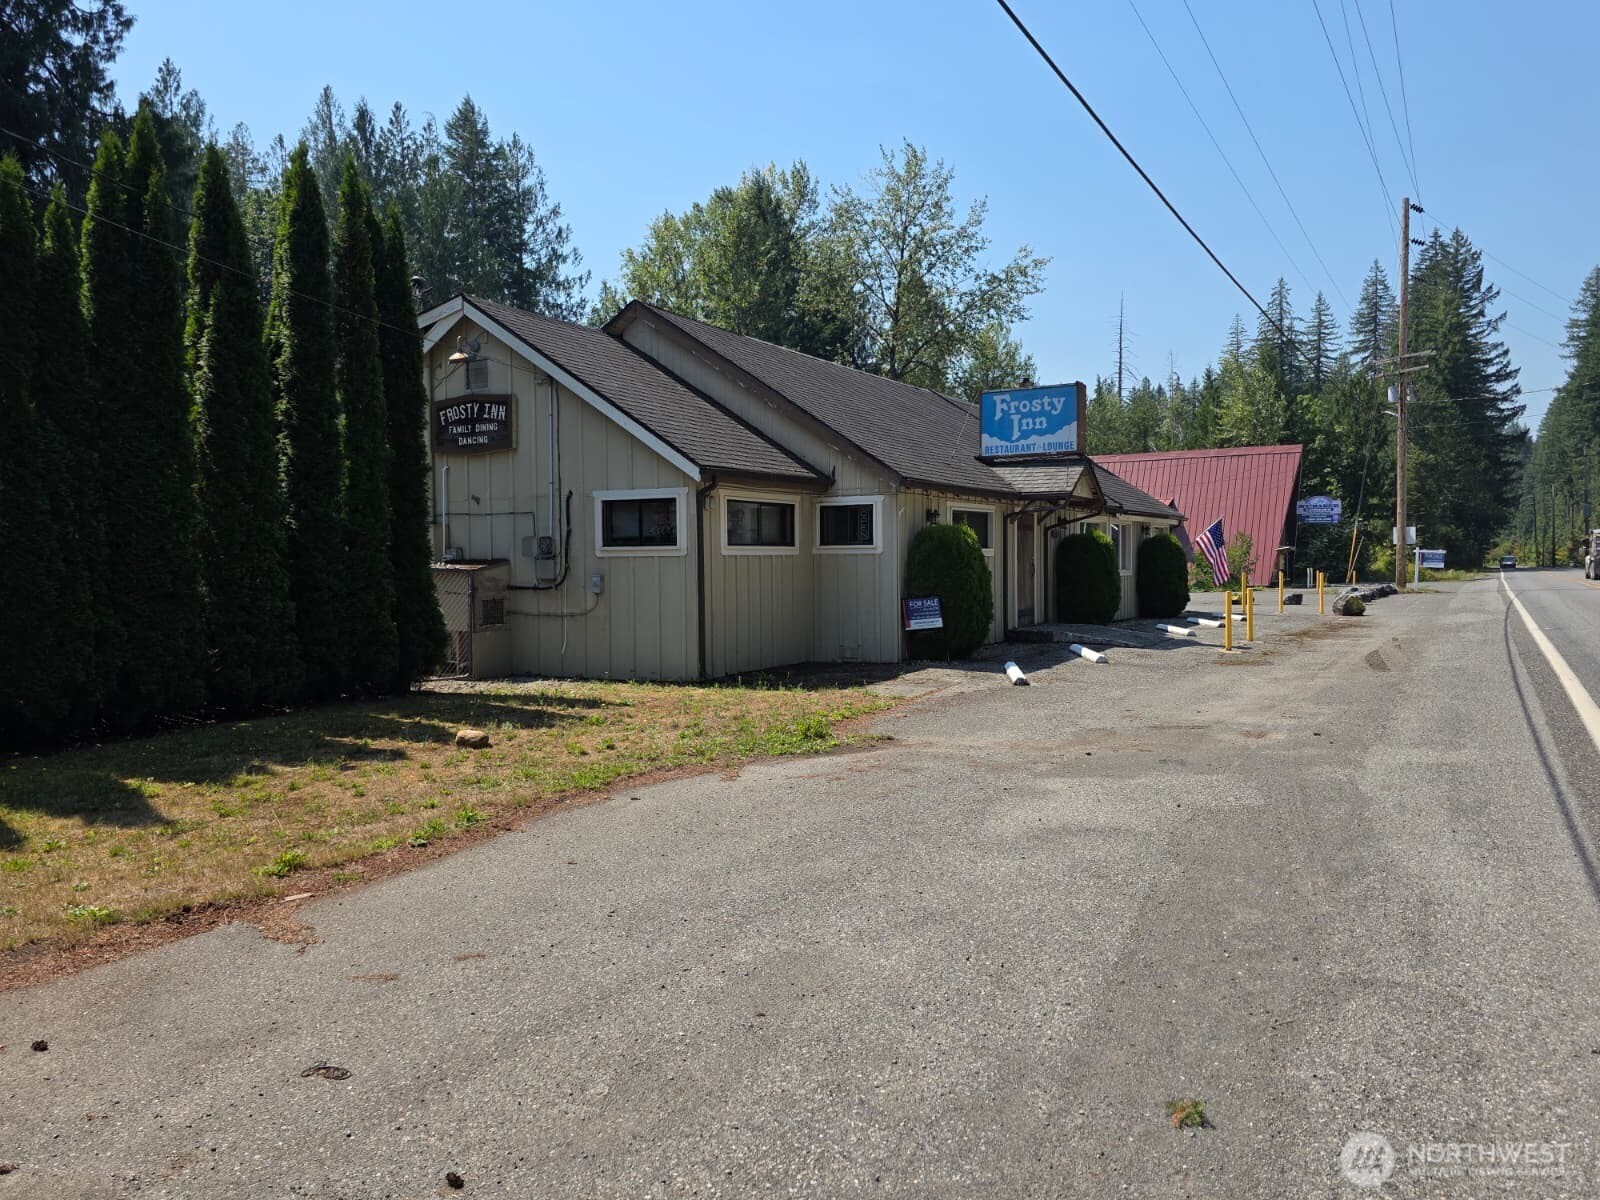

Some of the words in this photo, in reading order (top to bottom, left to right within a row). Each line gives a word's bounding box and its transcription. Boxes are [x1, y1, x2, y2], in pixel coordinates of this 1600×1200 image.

[993, 394, 1066, 421] Frosty
[440, 402, 480, 425] FROSTY
[483, 403, 506, 420] INN
[448, 425, 471, 433] FAMILY
[475, 422, 498, 431] DINING
[1010, 414, 1048, 441] Inn
[458, 435, 489, 446] DANCING
[984, 443, 1037, 454] RESTAURANT
[924, 598, 939, 607] SALE
